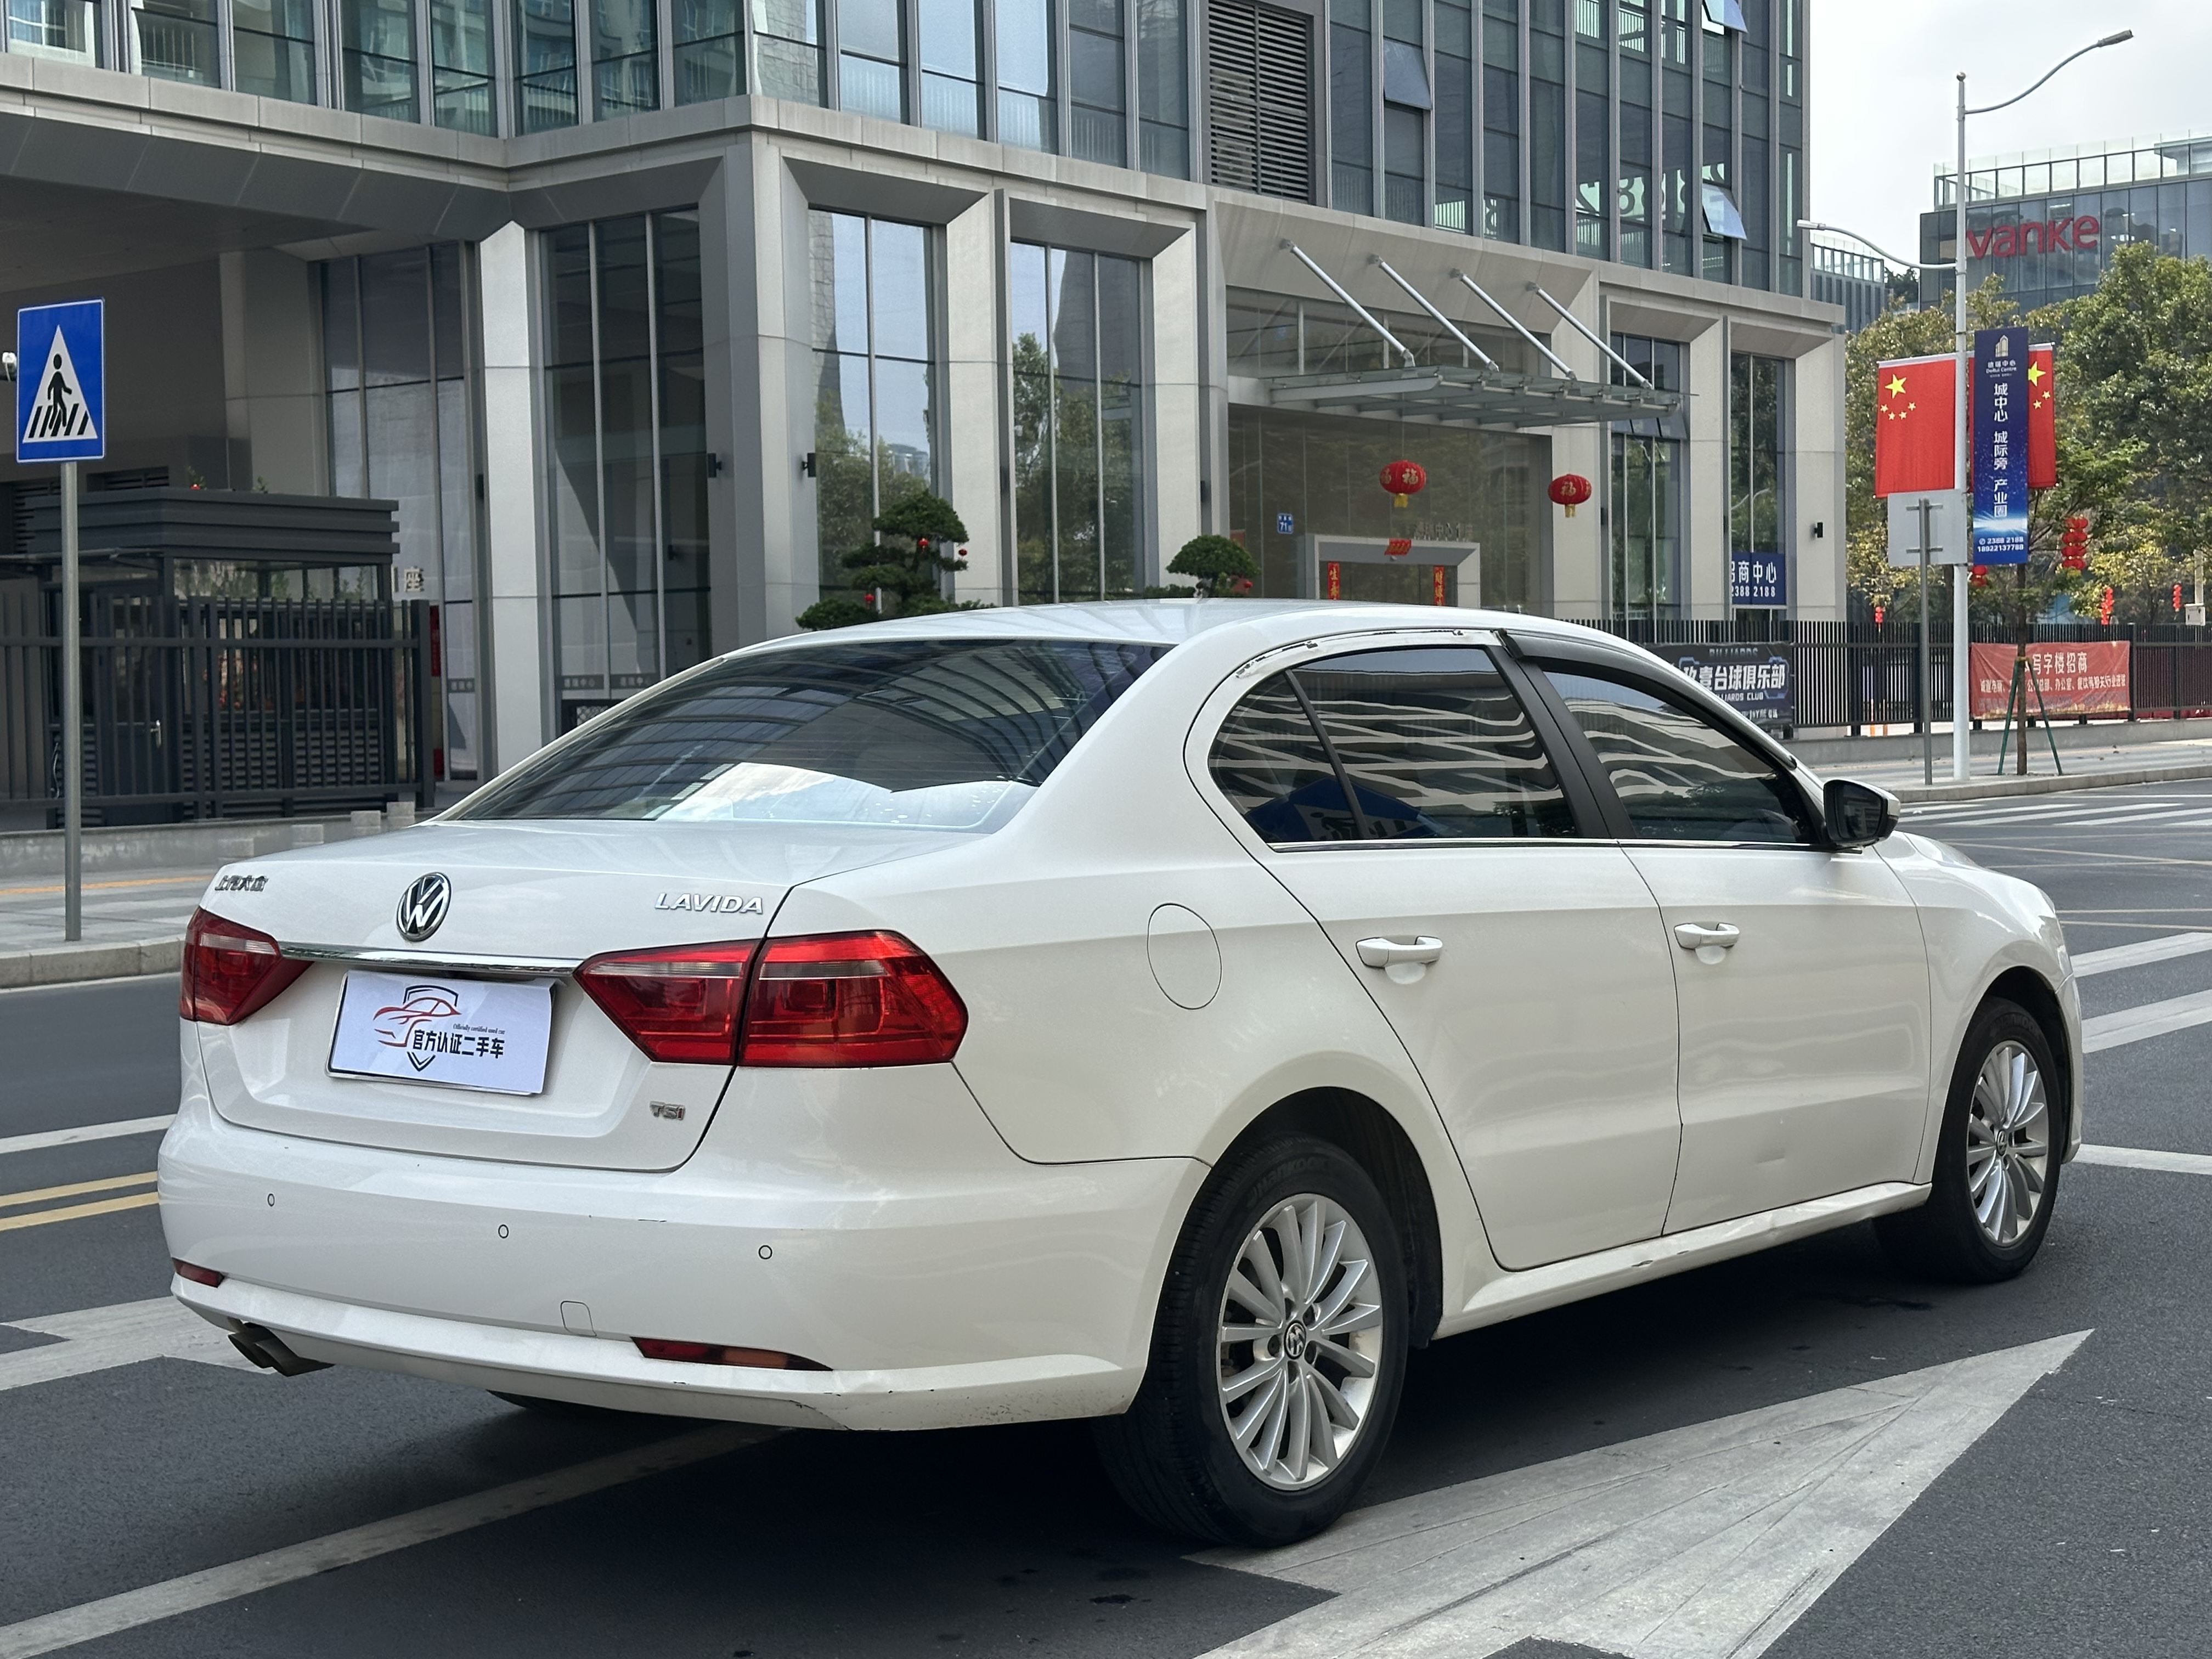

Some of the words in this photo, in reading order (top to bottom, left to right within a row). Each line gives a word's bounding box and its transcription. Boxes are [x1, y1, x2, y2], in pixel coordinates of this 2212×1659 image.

[1966, 216, 2099, 259] vanke
[1994, 382, 2008, 422] 城中心
[1994, 431, 2008, 470] 城际旁
[1402, 467, 1419, 484] 福
[1994, 479, 2008, 518] 产业圈
[1753, 586, 1775, 597] 2188
[1747, 692, 1764, 701] CLUB
[654, 893, 763, 915] LAVIDA
[413, 1029, 505, 1059] 官方认证二手车
